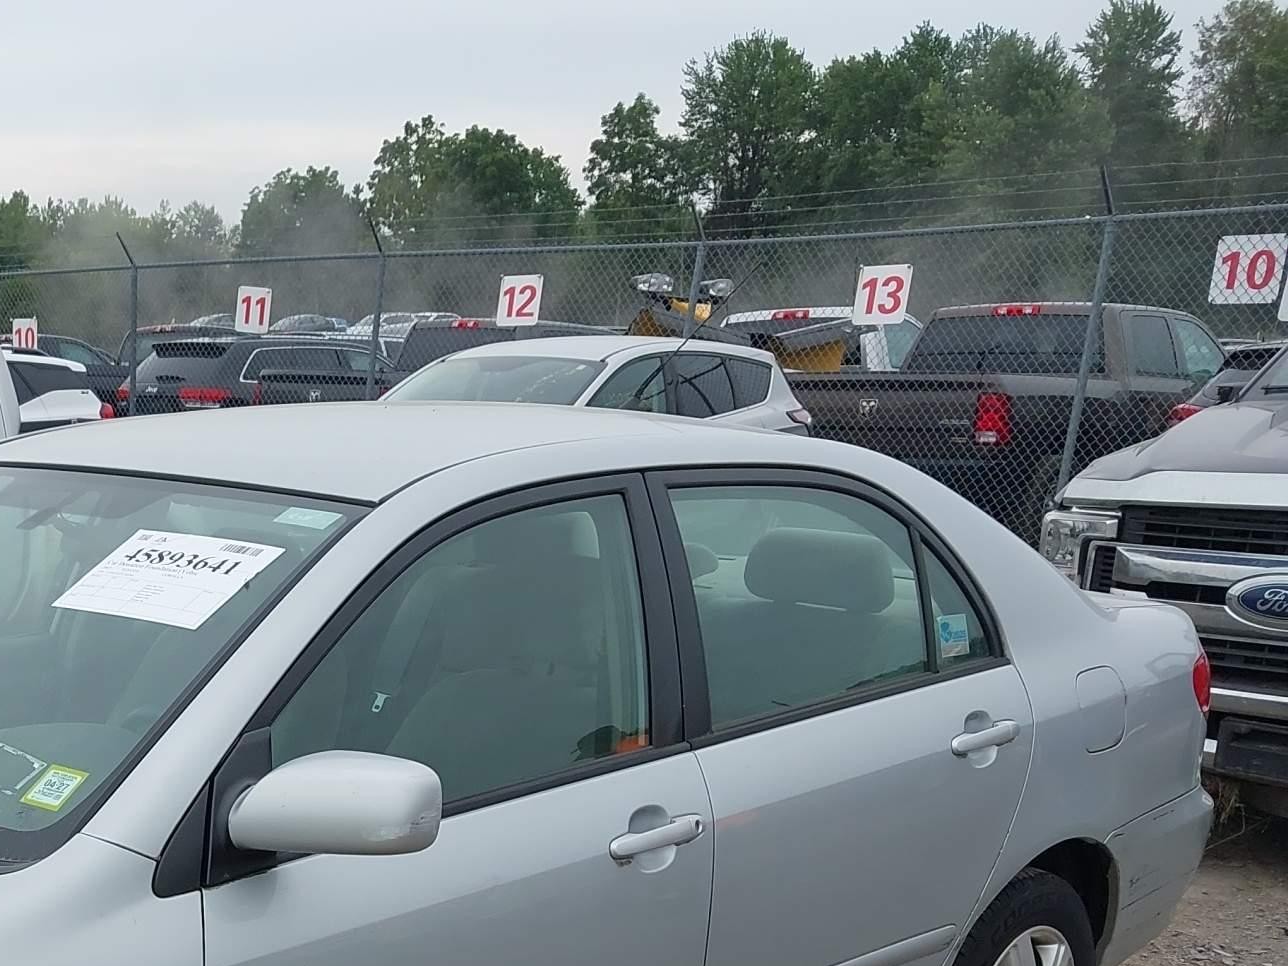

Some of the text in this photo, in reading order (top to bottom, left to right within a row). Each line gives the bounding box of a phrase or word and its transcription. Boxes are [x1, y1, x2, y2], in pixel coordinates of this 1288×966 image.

[1222, 249, 1276, 290] 10
[240, 294, 267, 327] 11
[503, 284, 537, 318] 12
[862, 275, 905, 315] 13
[14, 326, 35, 349] 10
[124, 547, 243, 577] 45893641
